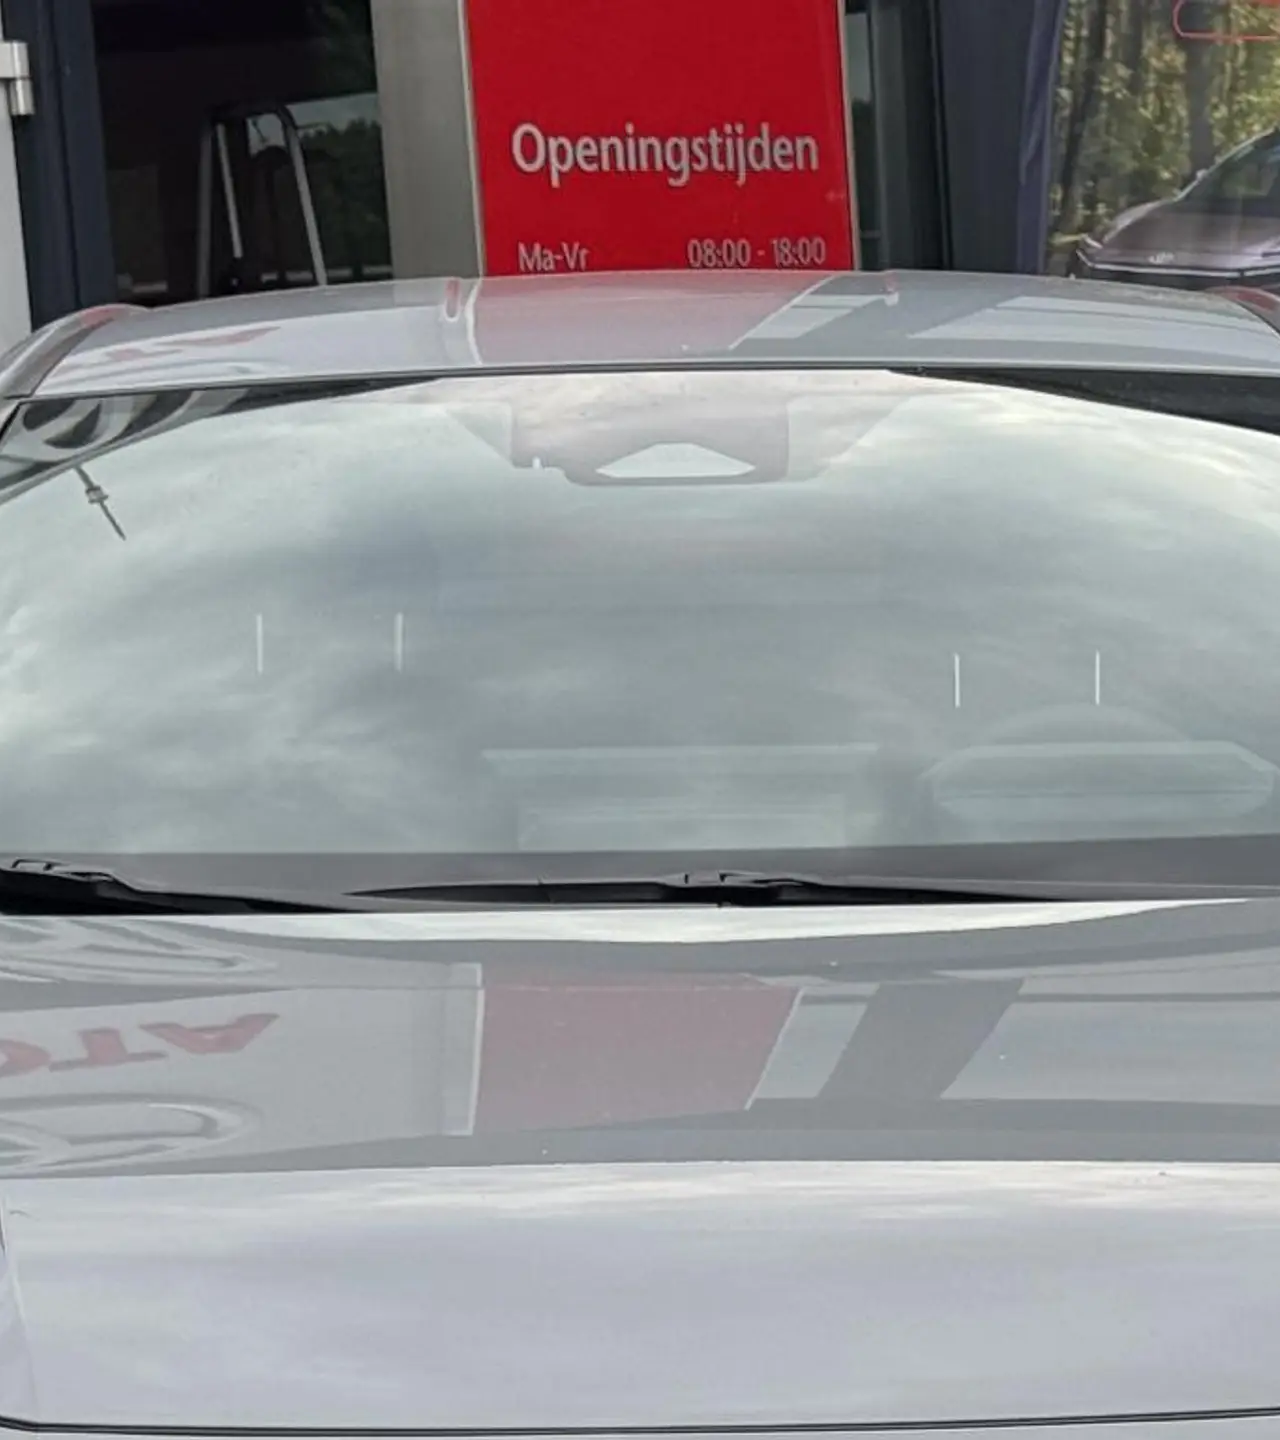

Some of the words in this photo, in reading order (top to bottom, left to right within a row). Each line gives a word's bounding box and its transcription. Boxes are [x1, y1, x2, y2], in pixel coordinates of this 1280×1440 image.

[512, 122, 819, 188] Openingstijden
[518, 241, 590, 272] Ma-Vr
[688, 239, 751, 267] 08:00
[772, 236, 826, 266] 18:00
